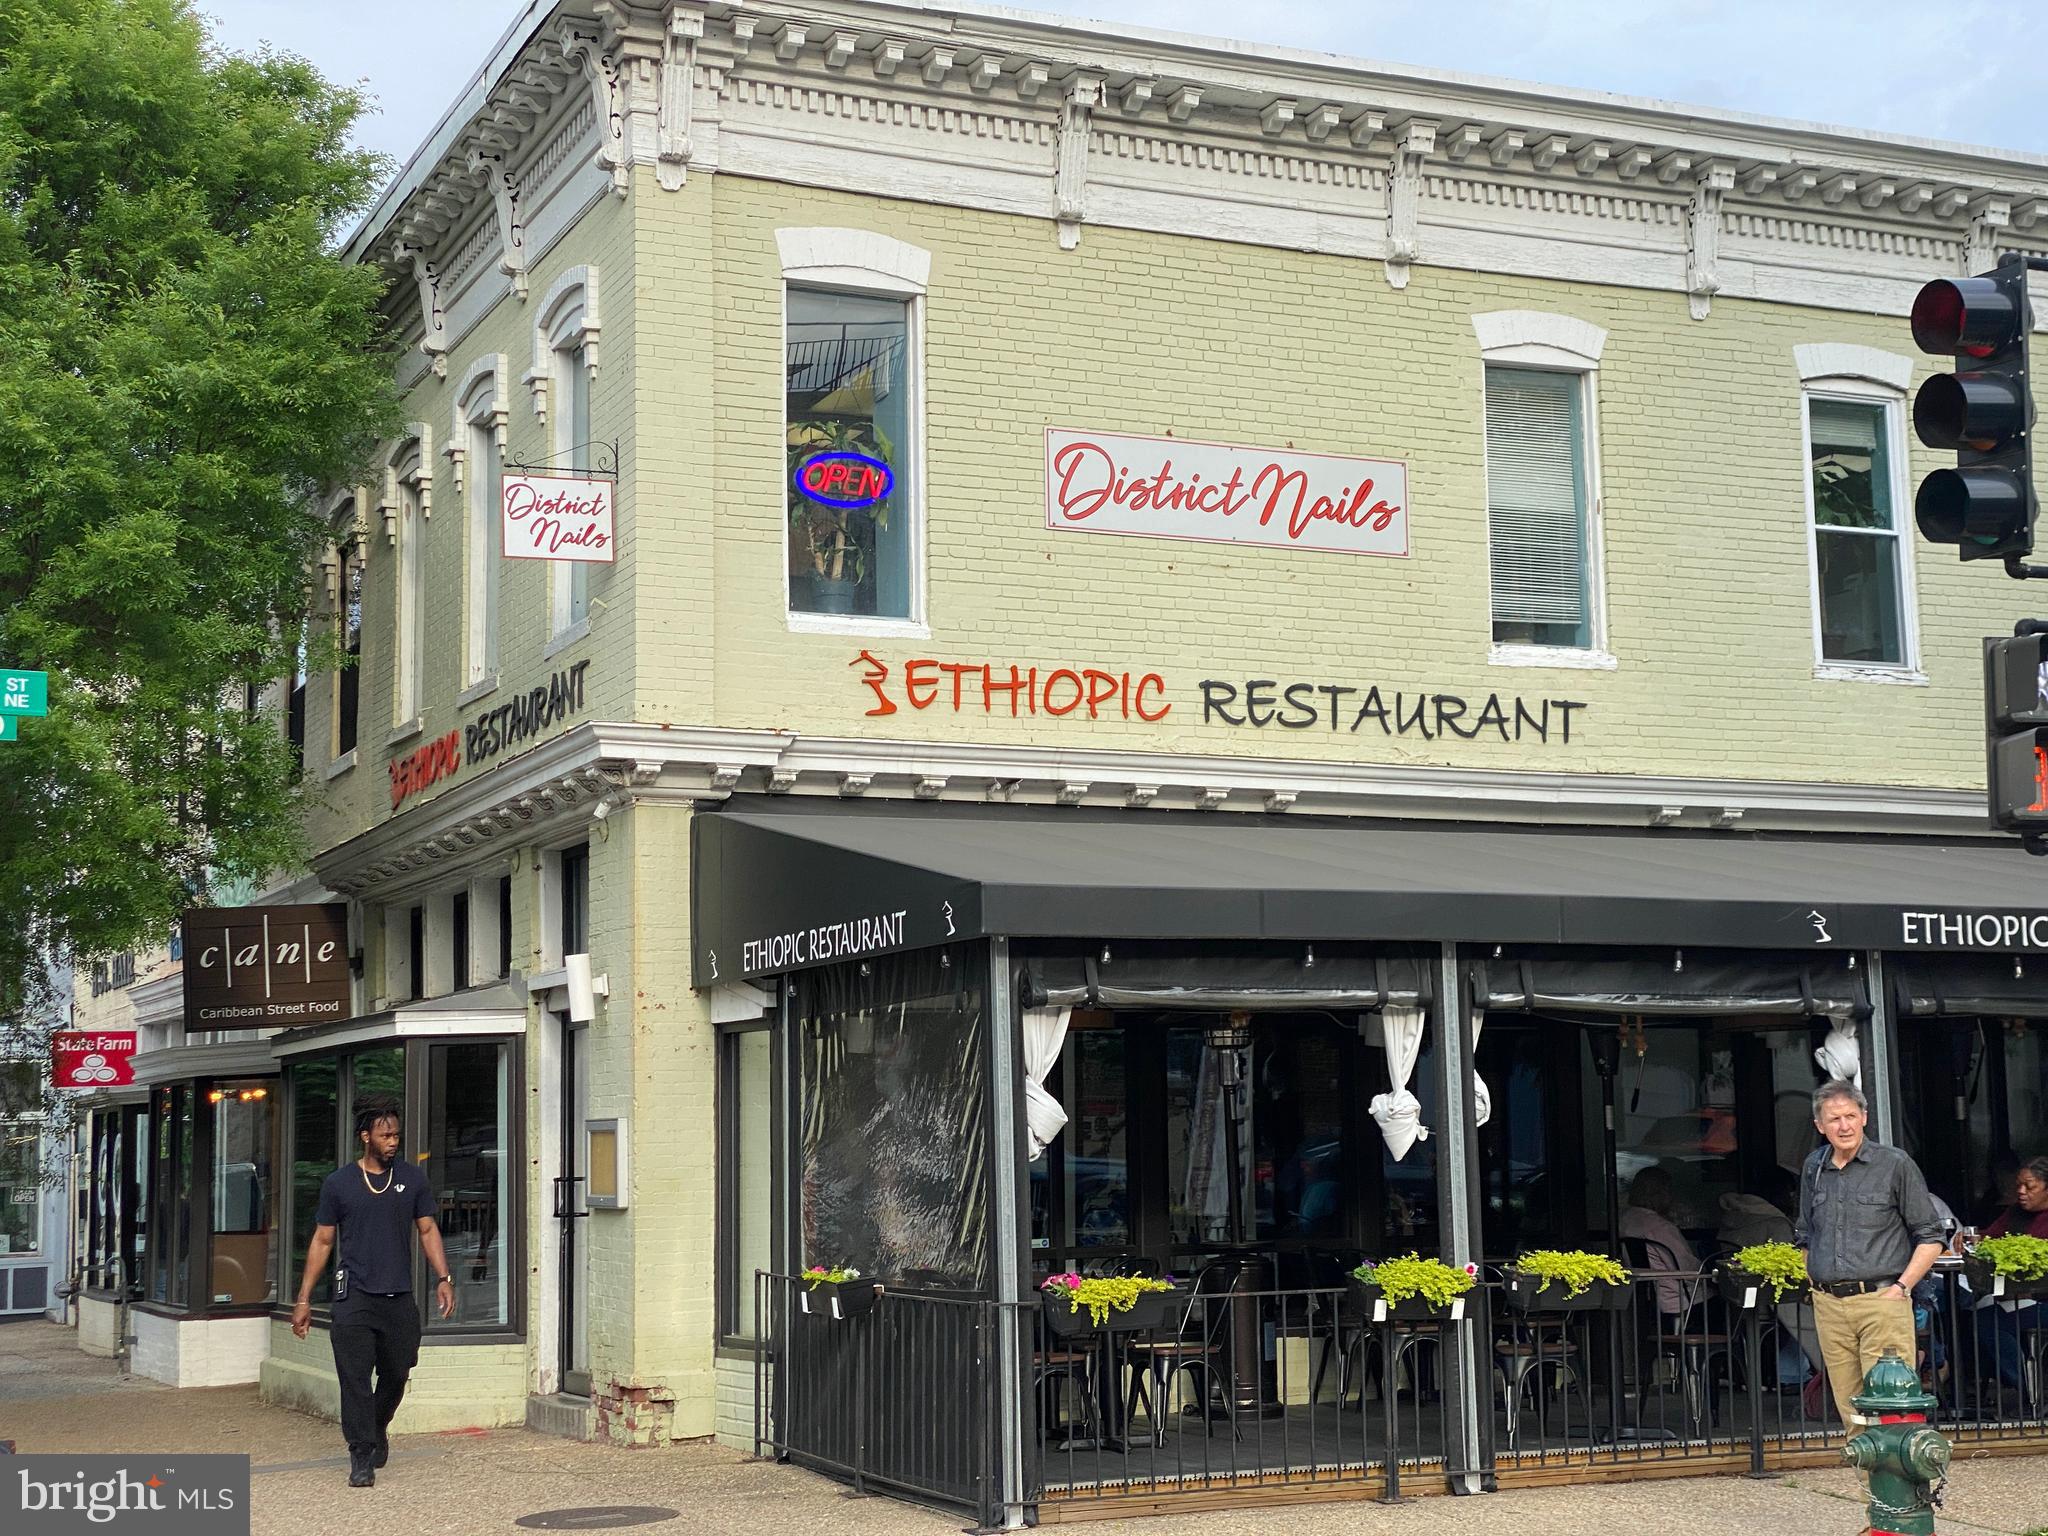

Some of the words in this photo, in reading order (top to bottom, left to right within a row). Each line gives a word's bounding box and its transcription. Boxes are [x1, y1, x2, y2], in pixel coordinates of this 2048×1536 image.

[803, 462, 886, 498] OPEN
[1054, 442, 1250, 521] District
[1251, 463, 1401, 539] Nails
[505, 483, 606, 520] District
[530, 517, 611, 553] Nails
[4, 693, 30, 708] NE
[6, 677, 30, 692] ST
[904, 658, 1172, 722] ETHIOPIC
[1198, 679, 1588, 745] RESTAURANT
[464, 658, 590, 766] RESTAURANT
[743, 931, 805, 972] ETHIOPIC
[809, 910, 906, 961] RESTAURANT
[1902, 912, 2048, 948] ETHIOPIC
[200, 1006, 263, 1020] Caribbean
[267, 1003, 305, 1016] Street
[308, 1001, 339, 1013] Food
[57, 1036, 95, 1052] State
[96, 1036, 132, 1051] Farm
